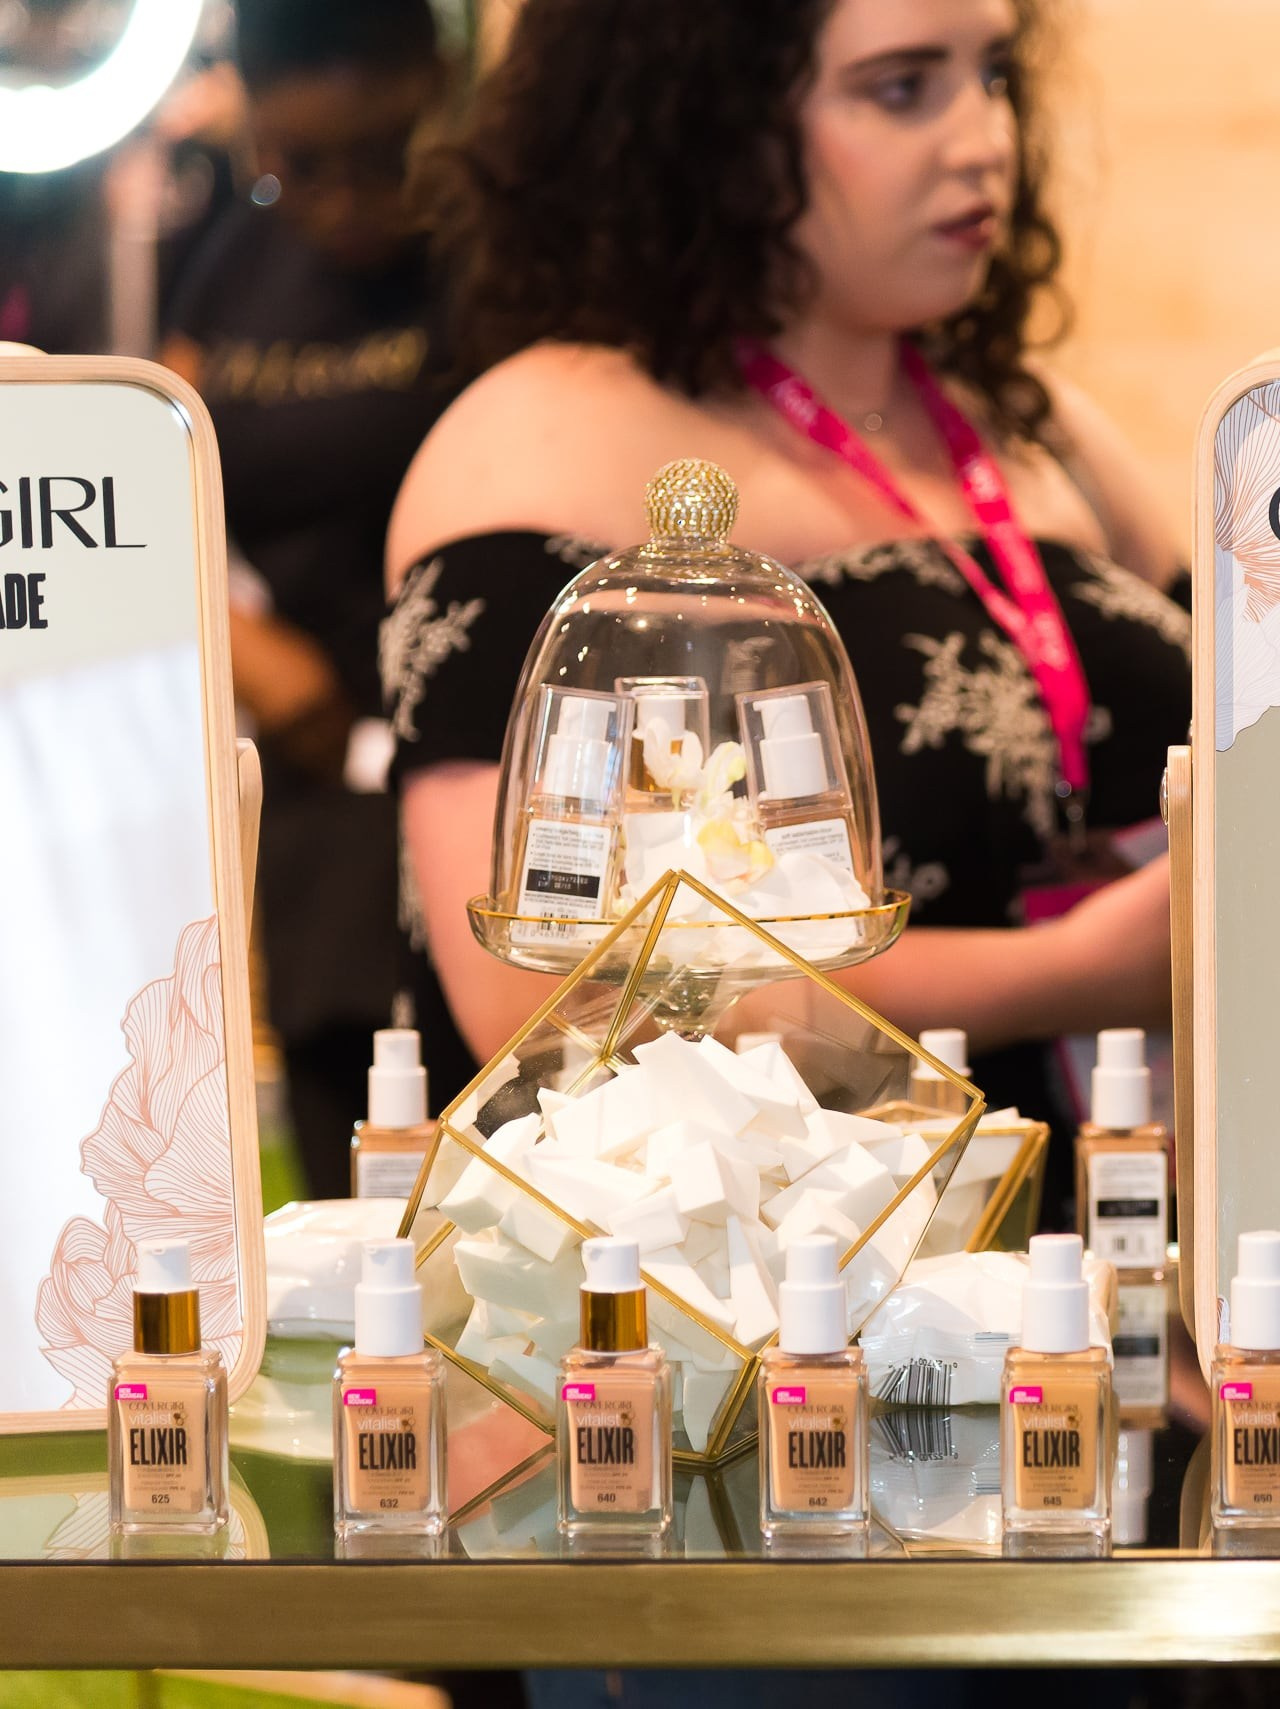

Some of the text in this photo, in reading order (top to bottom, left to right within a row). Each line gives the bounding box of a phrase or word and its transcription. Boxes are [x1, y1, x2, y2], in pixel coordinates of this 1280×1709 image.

[0, 476, 148, 549] IRL
[0, 572, 48, 629] DE
[129, 1402, 184, 1410] COVERGIRL
[130, 1412, 172, 1425] vitalist
[358, 1418, 400, 1430] vitalist
[577, 1413, 619, 1426] vitalist
[789, 1417, 831, 1429] vitalist
[1024, 1416, 1066, 1429] vitalist
[1234, 1412, 1277, 1425] vitalist
[130, 1428, 187, 1465] ELIXIR
[359, 1433, 416, 1470] ELIXIR
[577, 1427, 634, 1464] ELIXIR
[789, 1431, 845, 1468] ELIXIR
[1023, 1431, 1080, 1467] ELIXIR
[152, 1494, 170, 1503] 625
[380, 1499, 399, 1508] 632
[597, 1494, 615, 1503] 640
[809, 1497, 827, 1506] 642
